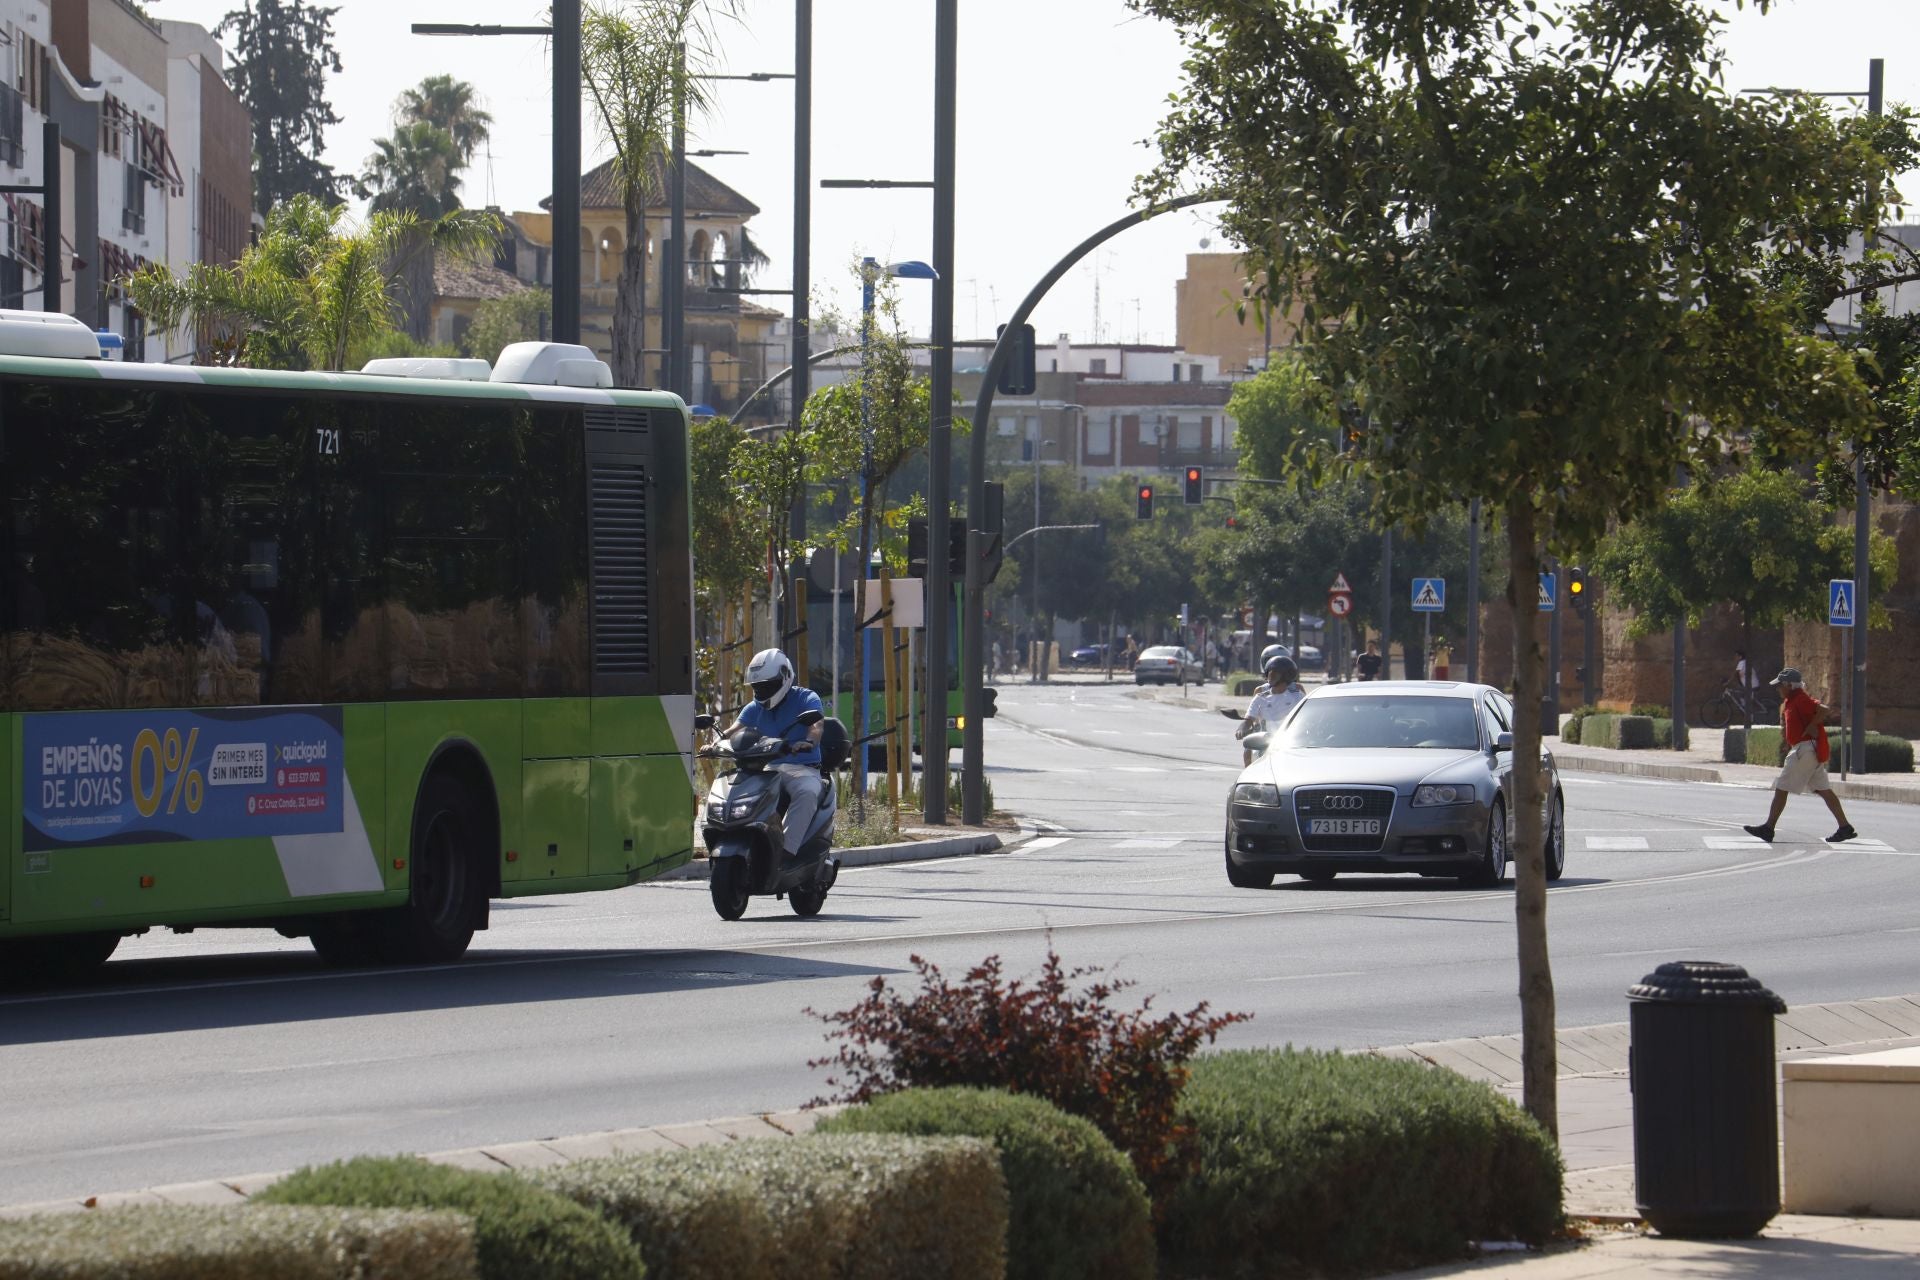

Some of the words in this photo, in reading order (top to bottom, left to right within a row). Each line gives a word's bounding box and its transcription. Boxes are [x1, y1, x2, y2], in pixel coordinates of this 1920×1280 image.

[316, 428, 339, 454] 721
[42, 737, 123, 775] EMPEÑOS
[217, 750, 246, 763] PRIMER
[248, 749, 264, 762] MES
[283, 740, 327, 764] quickgold
[131, 727, 204, 818] 0%
[213, 766, 227, 780] SIN
[229, 762, 264, 780] INTERÉS
[42, 779, 65, 809] DE
[69, 777, 123, 808] JOYAS
[1314, 820, 1348, 833] 7319
[1352, 820, 1378, 833] FTG
